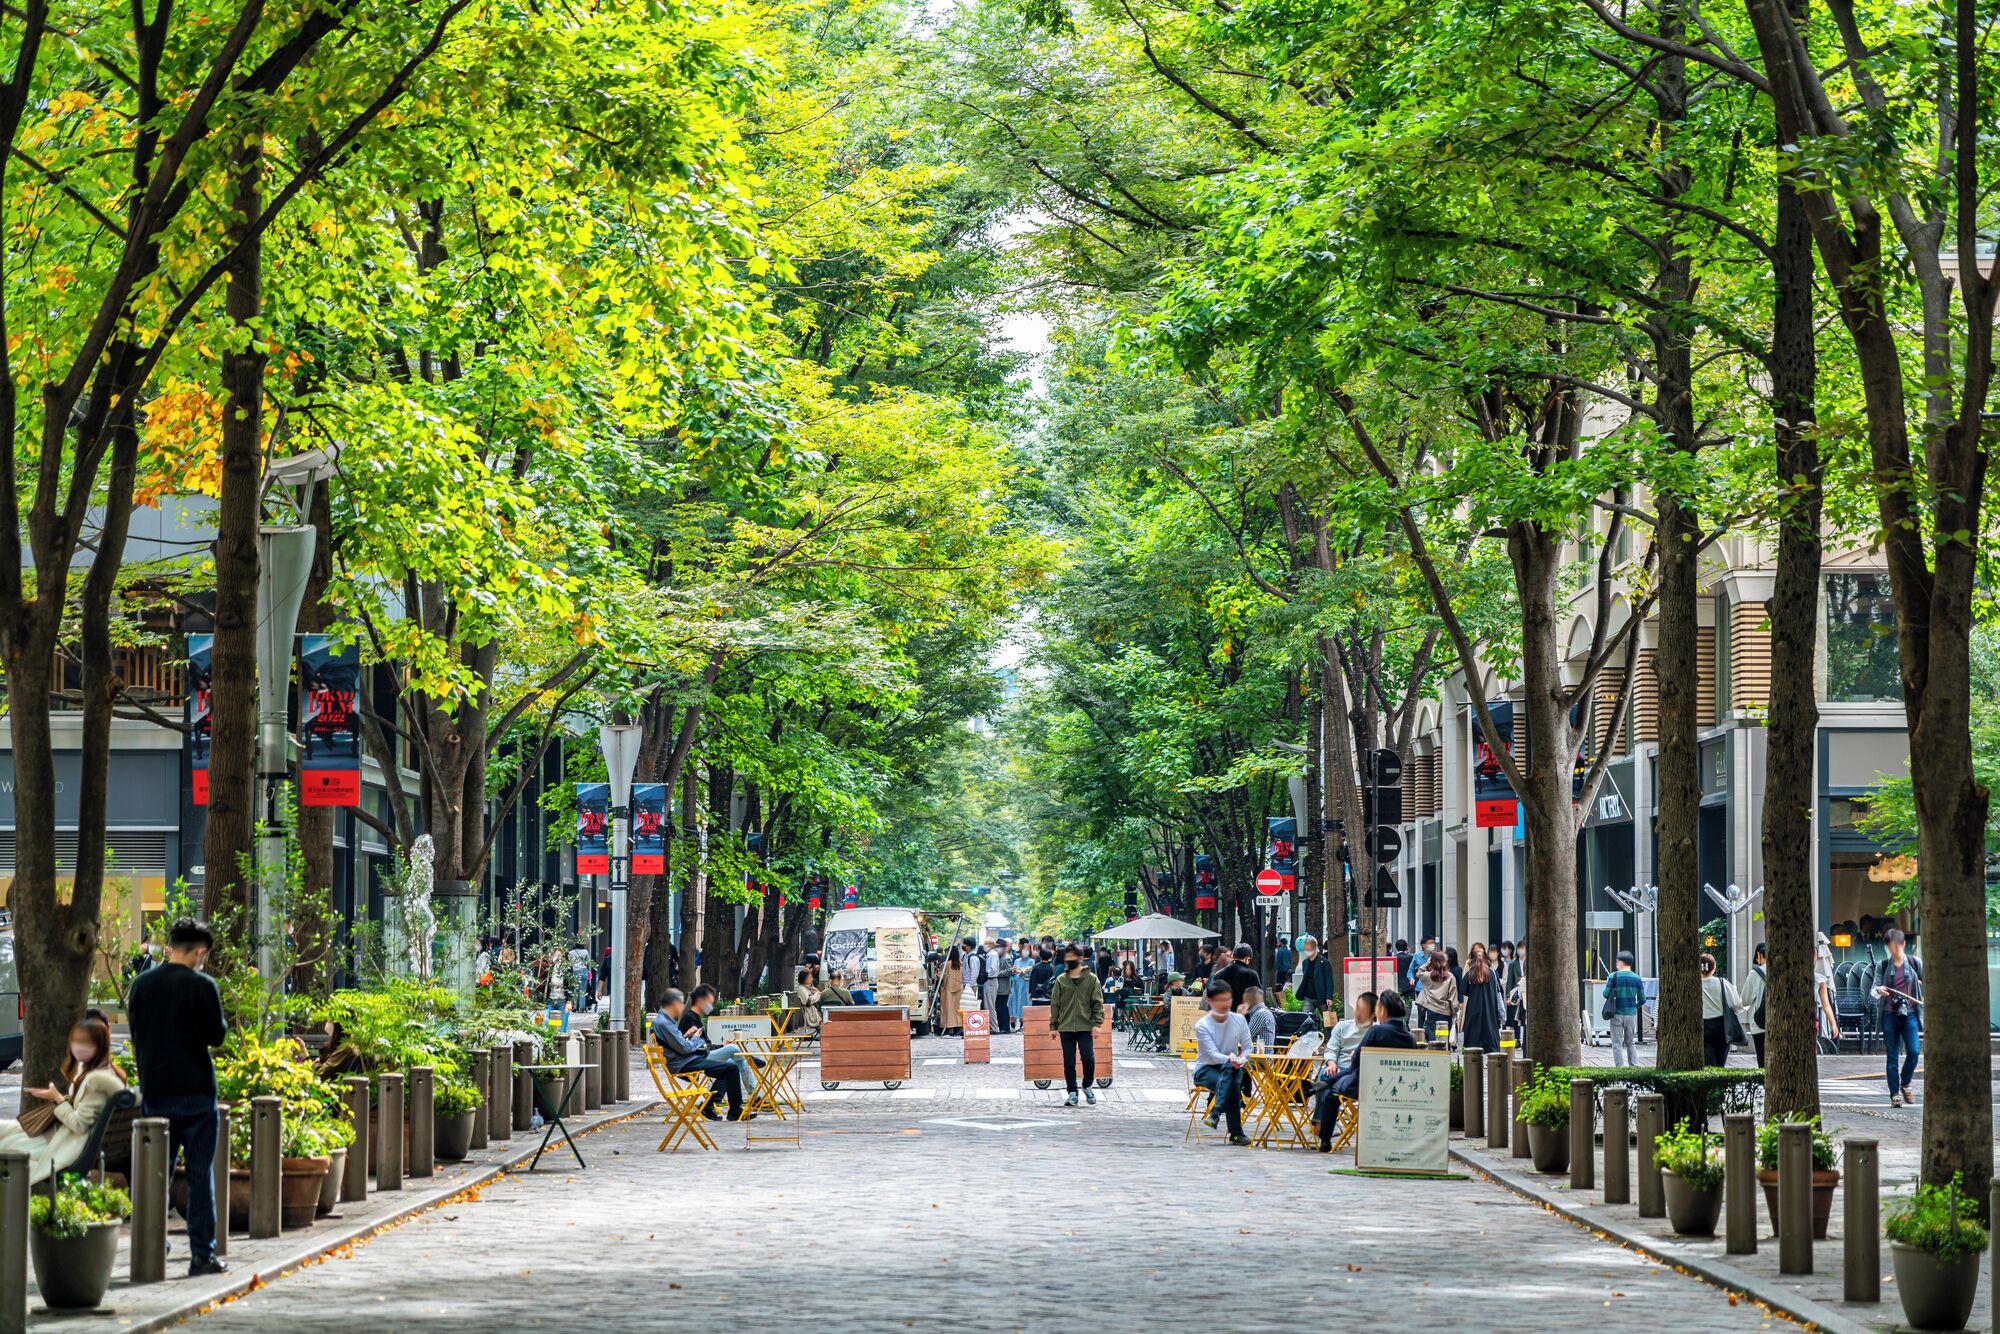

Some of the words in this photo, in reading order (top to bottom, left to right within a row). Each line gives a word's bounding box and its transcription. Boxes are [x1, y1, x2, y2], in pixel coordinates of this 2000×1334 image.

[308, 689, 355, 702] TOKYO
[316, 713, 346, 723] 2022
[1403, 1060, 1430, 1068] TERRACE
